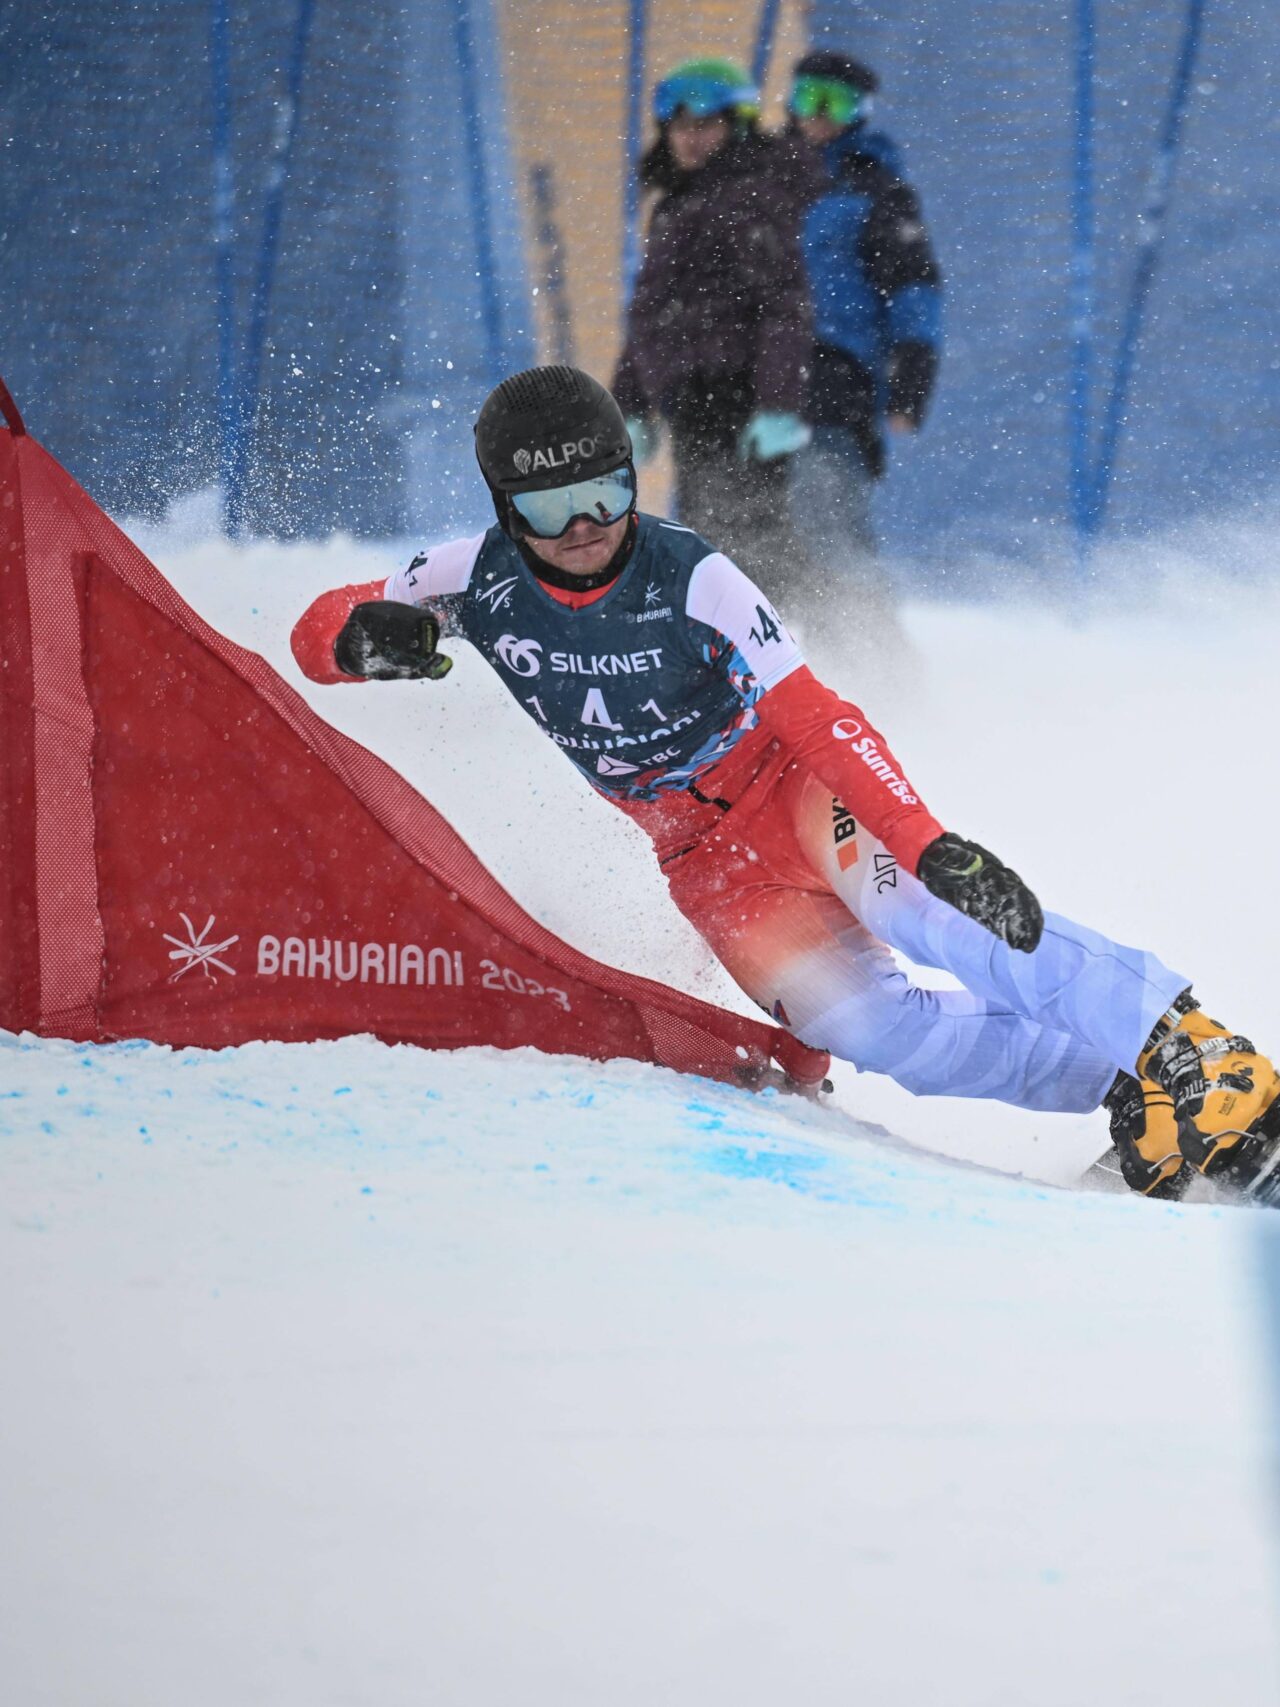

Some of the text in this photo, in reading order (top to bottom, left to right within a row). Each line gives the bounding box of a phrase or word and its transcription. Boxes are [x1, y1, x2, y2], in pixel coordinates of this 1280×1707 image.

[550, 648, 663, 676] SILKNET
[638, 746, 682, 766] TBC
[851, 737, 918, 805] Sunrise
[257, 935, 464, 986] BAKURIANI
